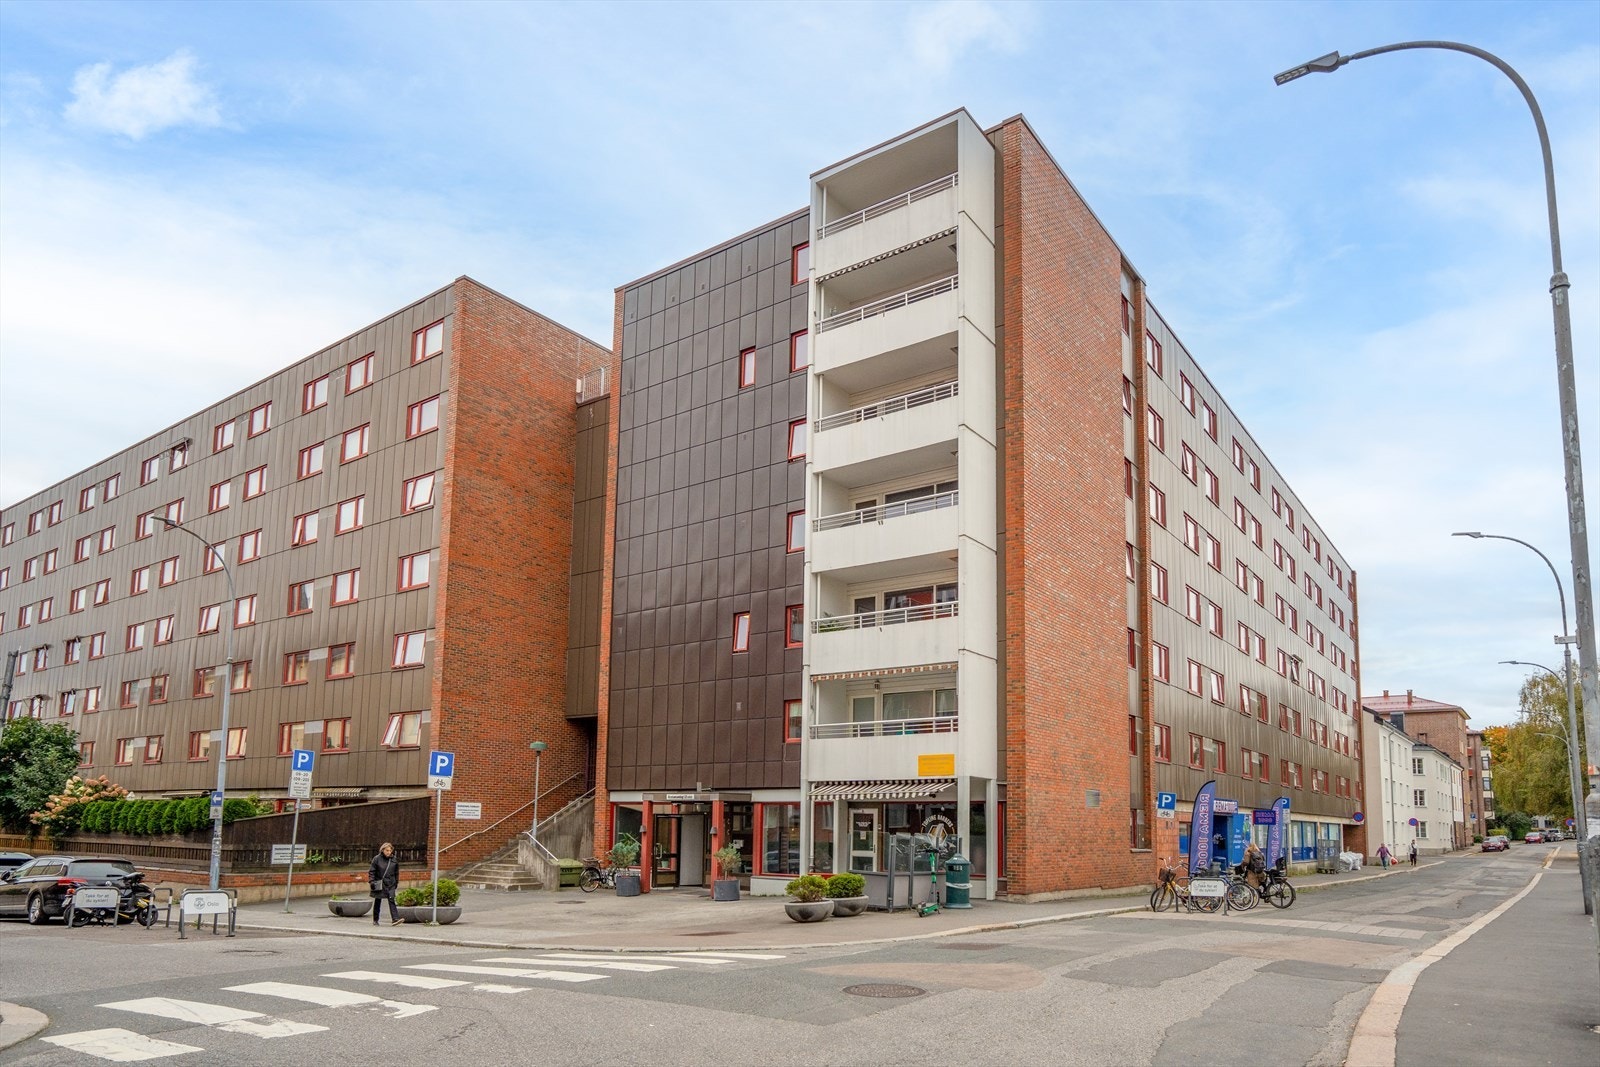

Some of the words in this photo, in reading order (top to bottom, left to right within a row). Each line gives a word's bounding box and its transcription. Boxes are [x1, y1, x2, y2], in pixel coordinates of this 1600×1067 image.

[298, 752, 310, 768] P
[436, 755, 449, 774] P
[1162, 794, 1172, 807] P
